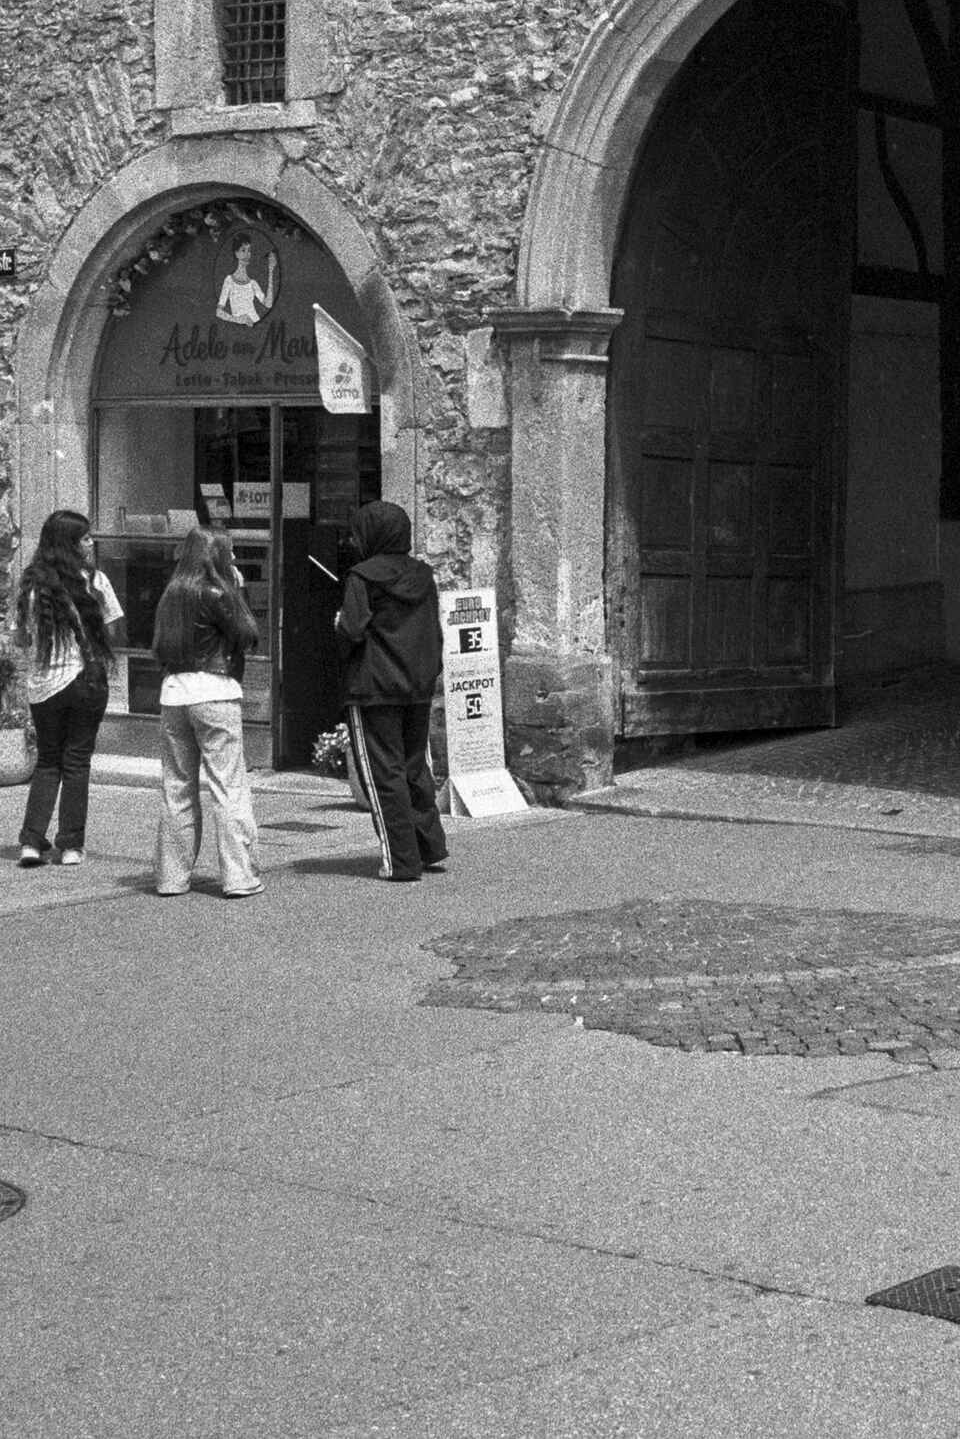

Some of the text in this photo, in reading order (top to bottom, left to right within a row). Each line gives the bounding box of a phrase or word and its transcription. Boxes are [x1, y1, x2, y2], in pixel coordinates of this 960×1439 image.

[160, 322, 229, 367] Adele
[175, 373, 212, 388] Lotto
[222, 372, 265, 388] Tabak
[332, 387, 360, 400] LOTTO
[249, 491, 272, 504] LOT
[455, 596, 482, 611] EURO
[447, 608, 491, 626] JACKPOT
[467, 630, 482, 650] 35
[449, 678, 495, 693] JACKPOT
[467, 697, 482, 716] 50
